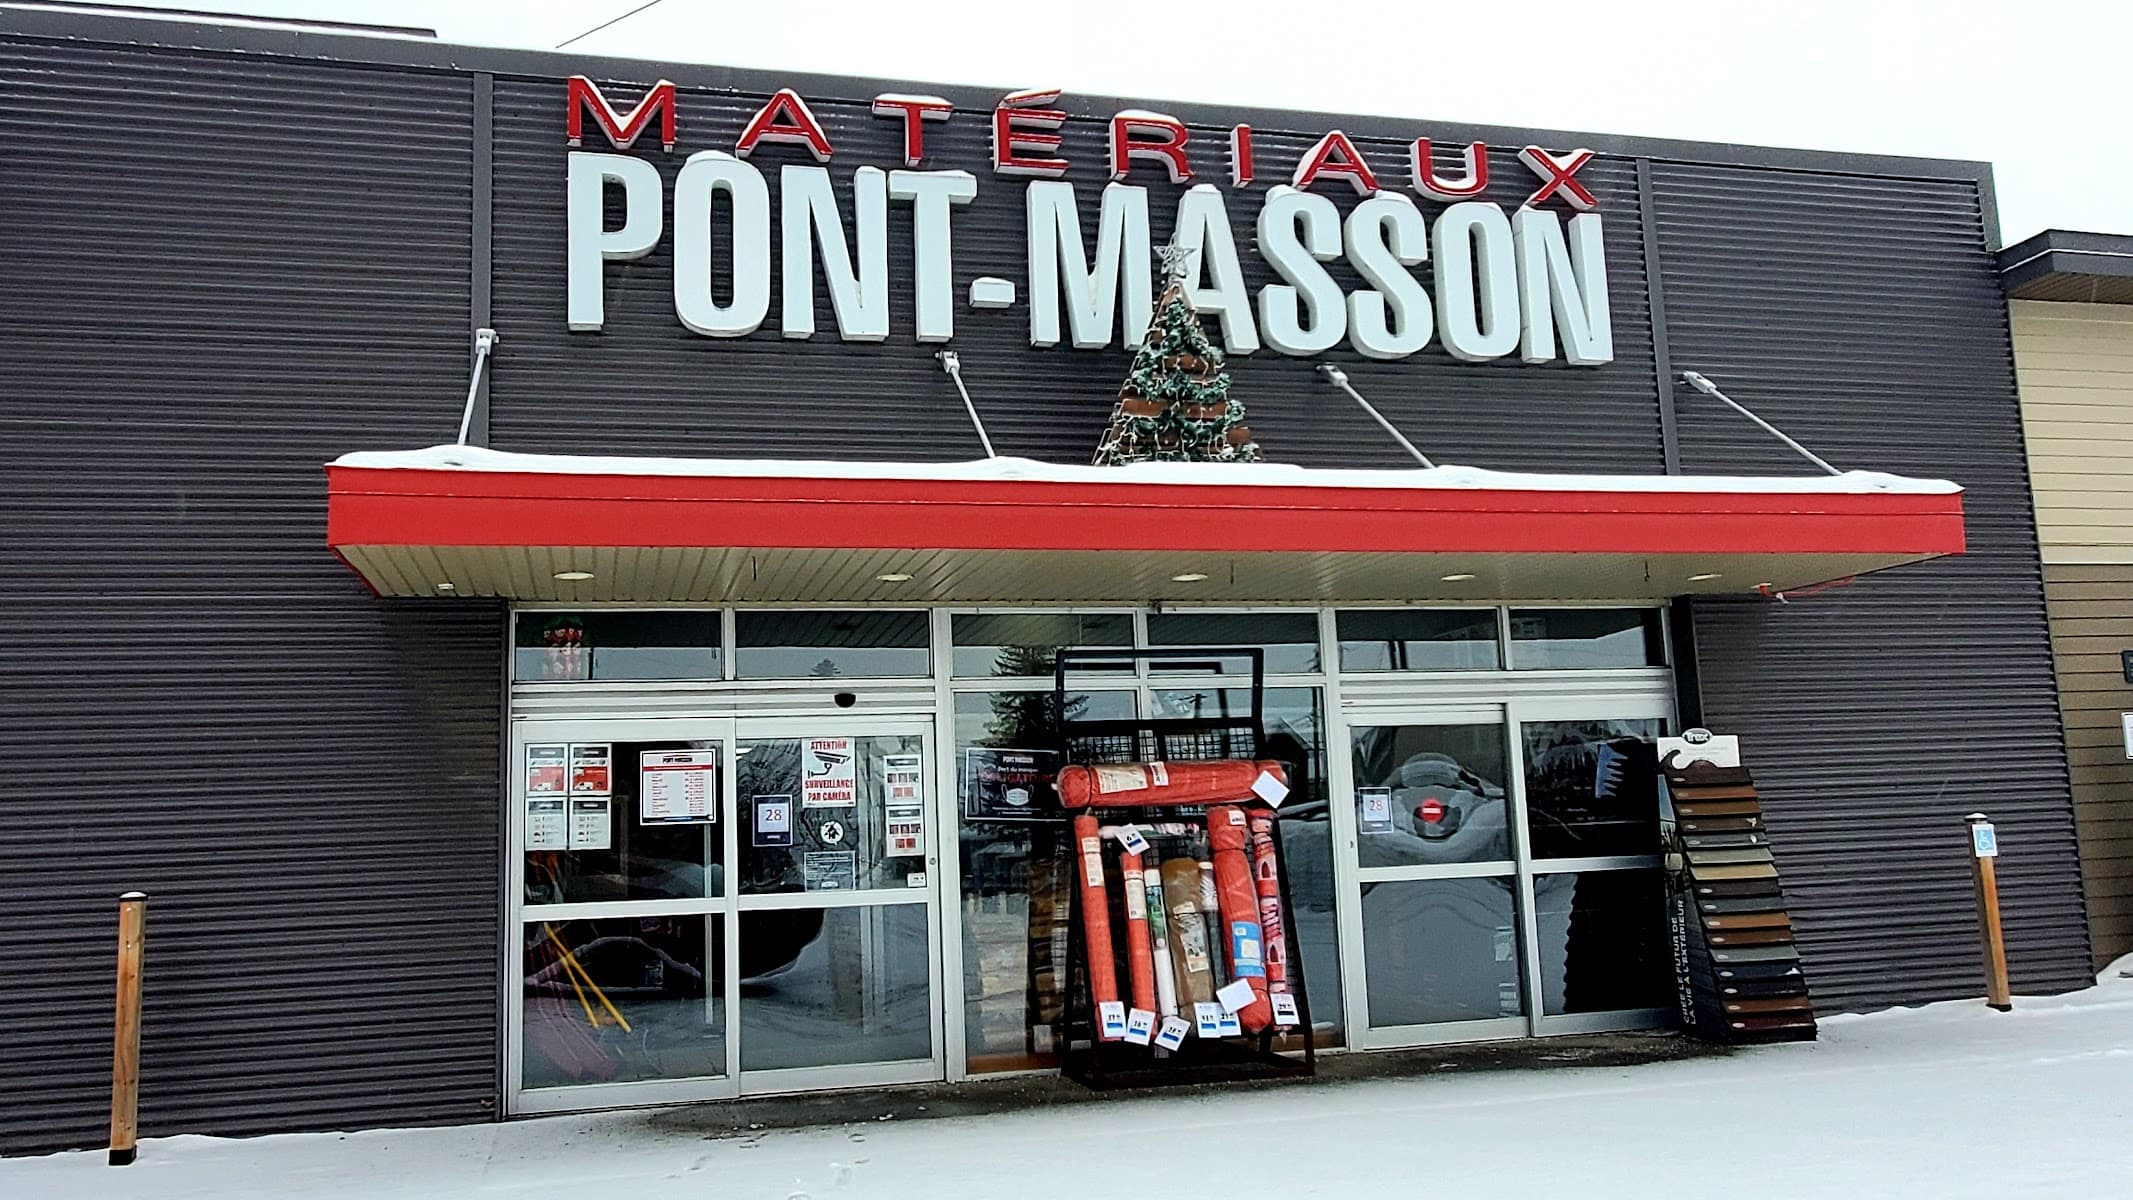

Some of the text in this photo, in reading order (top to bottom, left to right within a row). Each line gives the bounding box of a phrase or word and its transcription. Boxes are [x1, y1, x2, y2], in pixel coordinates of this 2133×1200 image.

[567, 75, 1598, 210] MATÉRIAUX
[567, 150, 1614, 366] PONT-MASSON
[811, 741, 847, 750] ATTENTION
[805, 779, 853, 788] SURVEILLANCE
[808, 790, 851, 801] PAR CAMÉRA
[1369, 800, 1383, 811] 28
[765, 809, 782, 821] 28
[1671, 917, 1678, 932] DE
[1685, 987, 1694, 1006] VIE
[1689, 1009, 1697, 1024] LA
